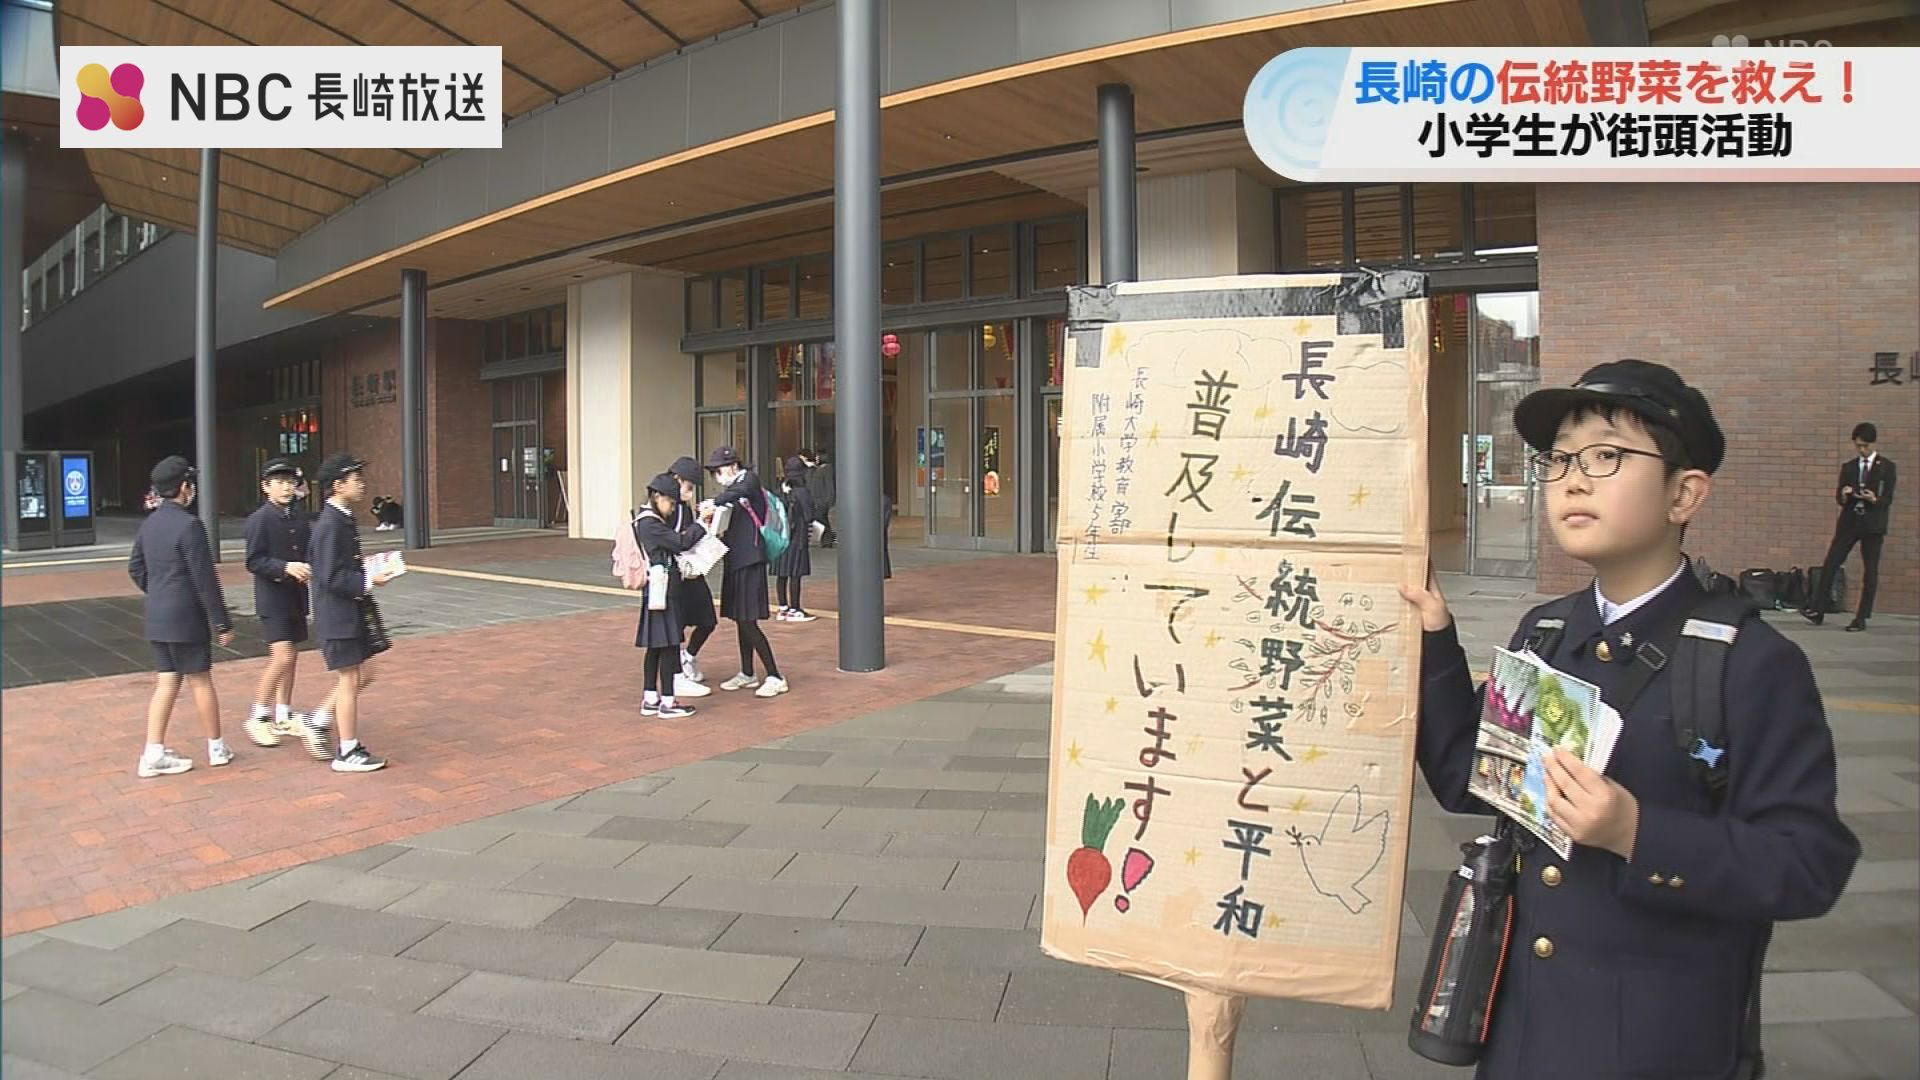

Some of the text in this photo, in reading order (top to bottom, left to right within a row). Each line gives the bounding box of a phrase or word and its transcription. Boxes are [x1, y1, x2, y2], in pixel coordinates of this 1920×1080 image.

[1213, 340, 1337, 939] 長崎伝統野菜と平和
